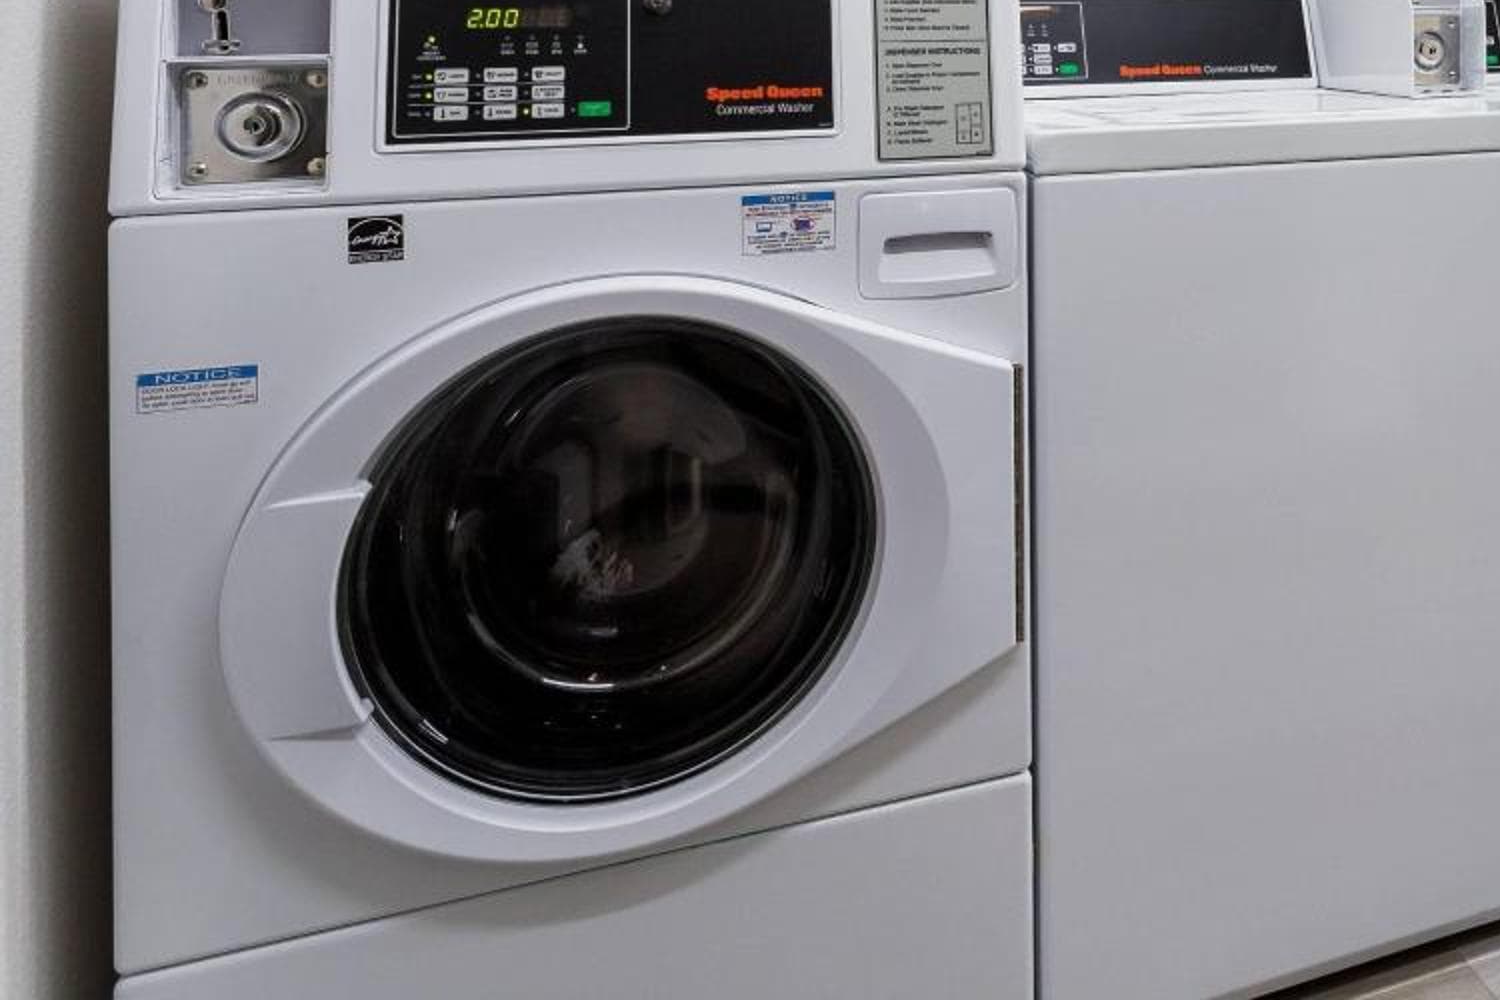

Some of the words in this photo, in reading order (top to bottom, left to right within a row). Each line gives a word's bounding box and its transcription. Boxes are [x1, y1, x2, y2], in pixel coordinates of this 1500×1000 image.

[467, 8, 519, 28] 2.00
[1120, 65, 1161, 78] Speed
[1162, 64, 1202, 75] Queen
[706, 86, 764, 102] Speed
[767, 85, 823, 99] Queen
[716, 103, 775, 115] Commercial
[778, 103, 815, 113] Washer
[154, 367, 241, 384] NOTICE
